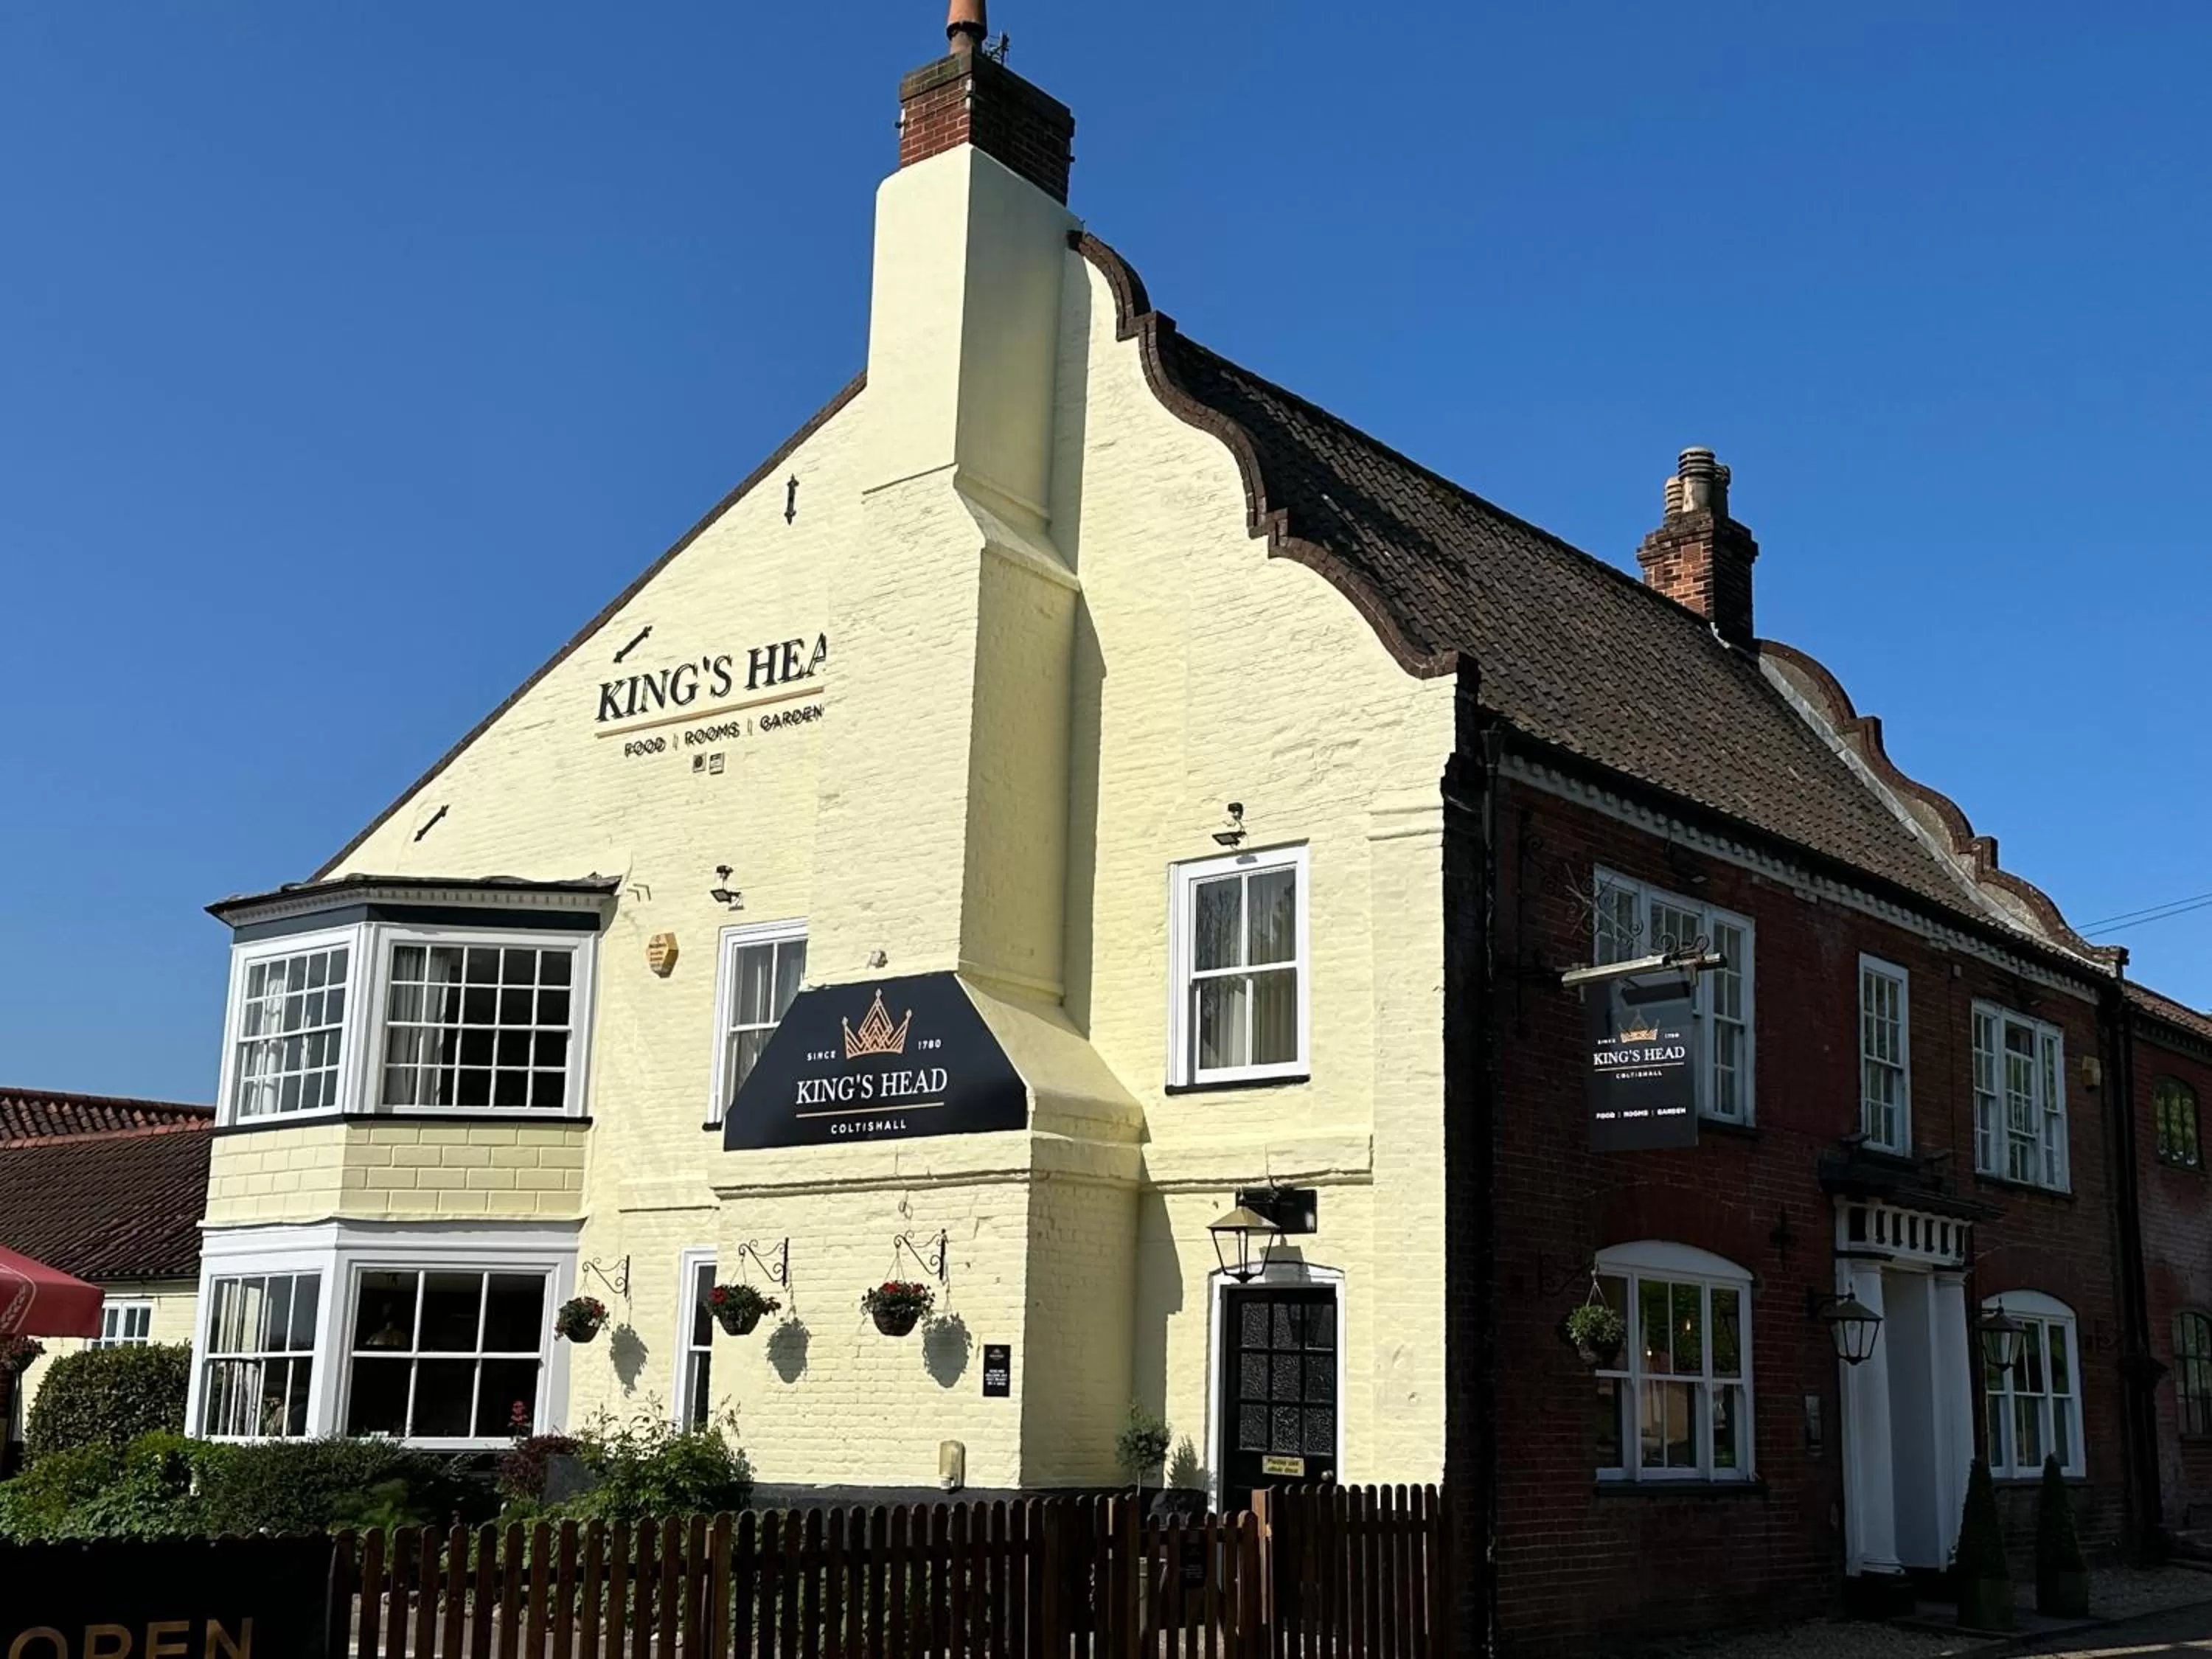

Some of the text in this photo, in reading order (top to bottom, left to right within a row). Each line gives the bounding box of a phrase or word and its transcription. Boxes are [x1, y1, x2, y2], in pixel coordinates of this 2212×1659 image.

[595, 654, 733, 723] KING'S
[625, 737, 666, 757] FOOD
[684, 723, 740, 745] ROOMS
[807, 1039, 942, 1061] SINCE 1780
[1593, 1046, 1686, 1065] KING'S HEAD
[1616, 1071, 1663, 1079] COLTISHALL
[796, 1068, 947, 1105] KING'S HEAD
[1658, 1107, 1686, 1116] GARDEN
[831, 1119, 906, 1135] COLTISHALL
[8, 1617, 254, 1659] OPEN
